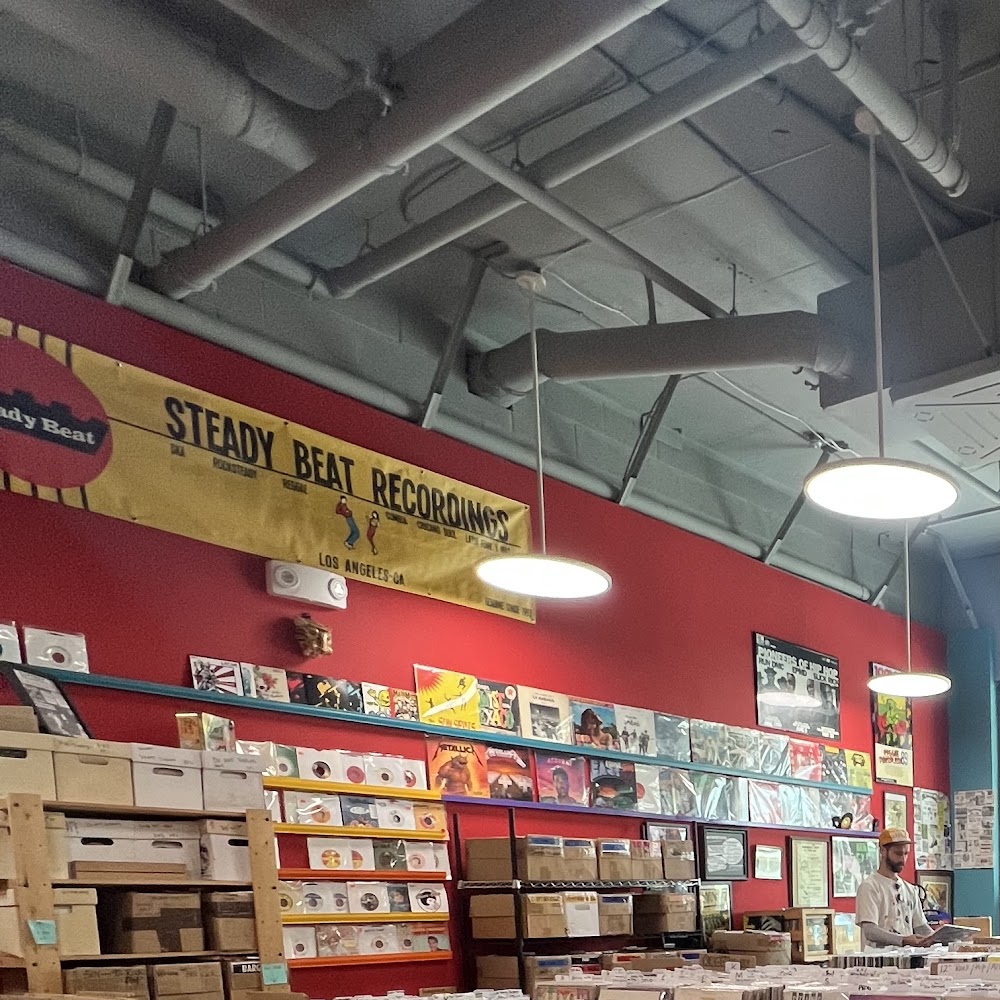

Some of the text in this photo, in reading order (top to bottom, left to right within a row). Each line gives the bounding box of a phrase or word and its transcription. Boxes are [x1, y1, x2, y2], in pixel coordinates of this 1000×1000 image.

[0, 405, 97, 445] ady Beat
[164, 396, 510, 542] STEADY BEAT RECORDINGS
[319, 552, 339, 570] LOS
[757, 646, 798, 667] PIONEERS
[799, 657, 810, 670] OF
[758, 656, 771, 666] RUN
[772, 659, 785, 671] DMC
